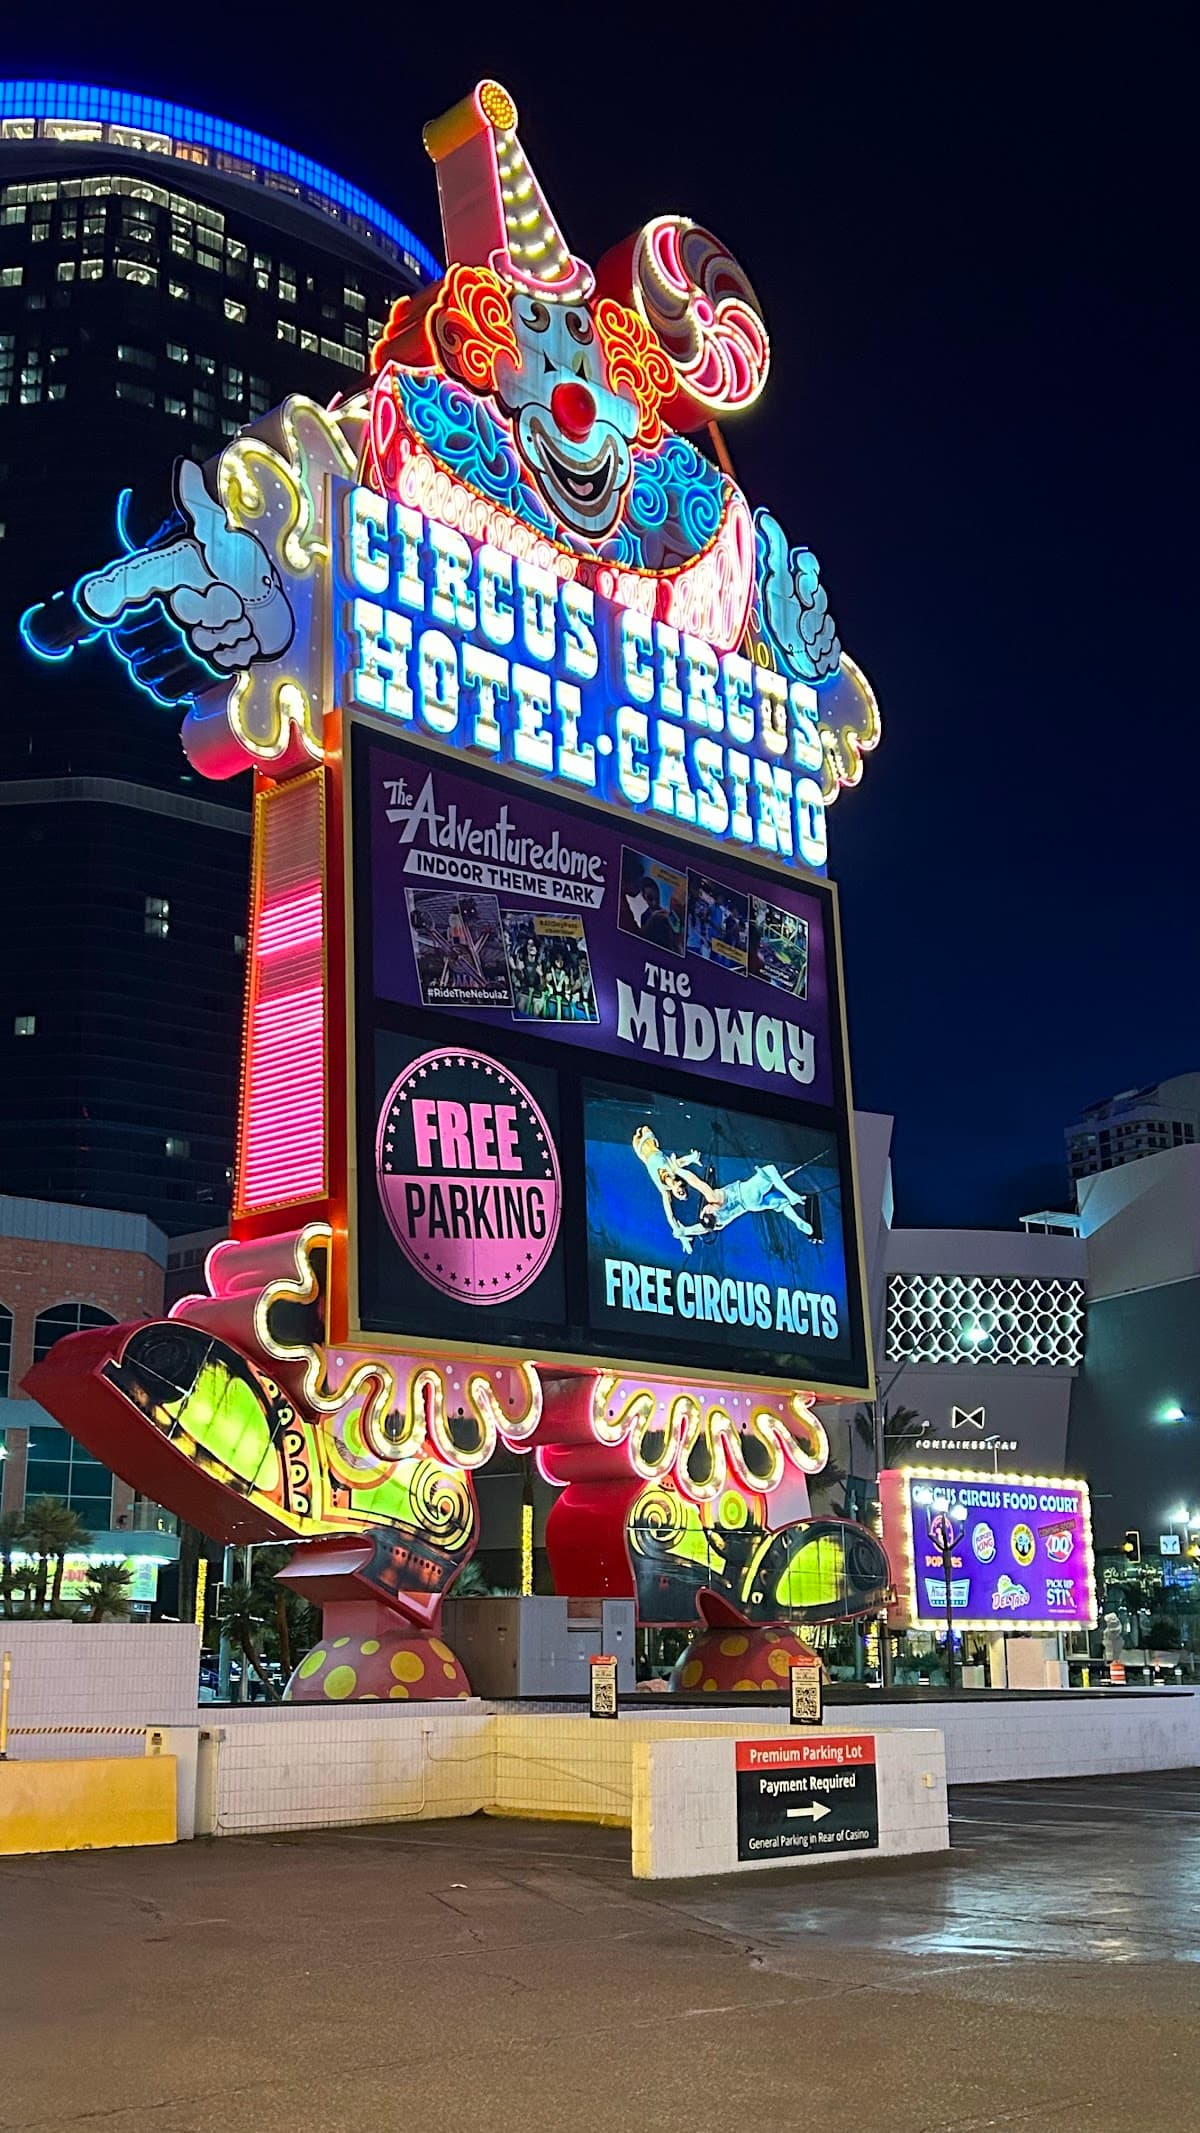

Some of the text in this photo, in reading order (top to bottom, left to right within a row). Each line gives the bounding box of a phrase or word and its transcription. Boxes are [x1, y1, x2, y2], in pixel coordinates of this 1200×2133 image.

[350, 486, 823, 772] CIRCUS CIRCUS
[353, 598, 827, 867] HOTEL CASINO
[383, 778, 413, 806] The
[385, 772, 605, 883] Adventuredome
[417, 854, 595, 904] INDOOR THEME PARK
[412, 1099, 523, 1171] FREE
[405, 1182, 546, 1240] PARKING
[605, 1257, 839, 1340] FREE CIRCUS ACTS
[959, 1489, 1000, 1508] CIRCUS
[1003, 1492, 1038, 1511] FOOD
[1040, 1495, 1079, 1513] COURT
[977, 1539, 993, 1552] KING
[750, 1744, 863, 1763] Premium Parking Lot
[760, 1774, 855, 1796] Payment Required
[749, 1829, 869, 1849] General Parking in Rear of Casino
